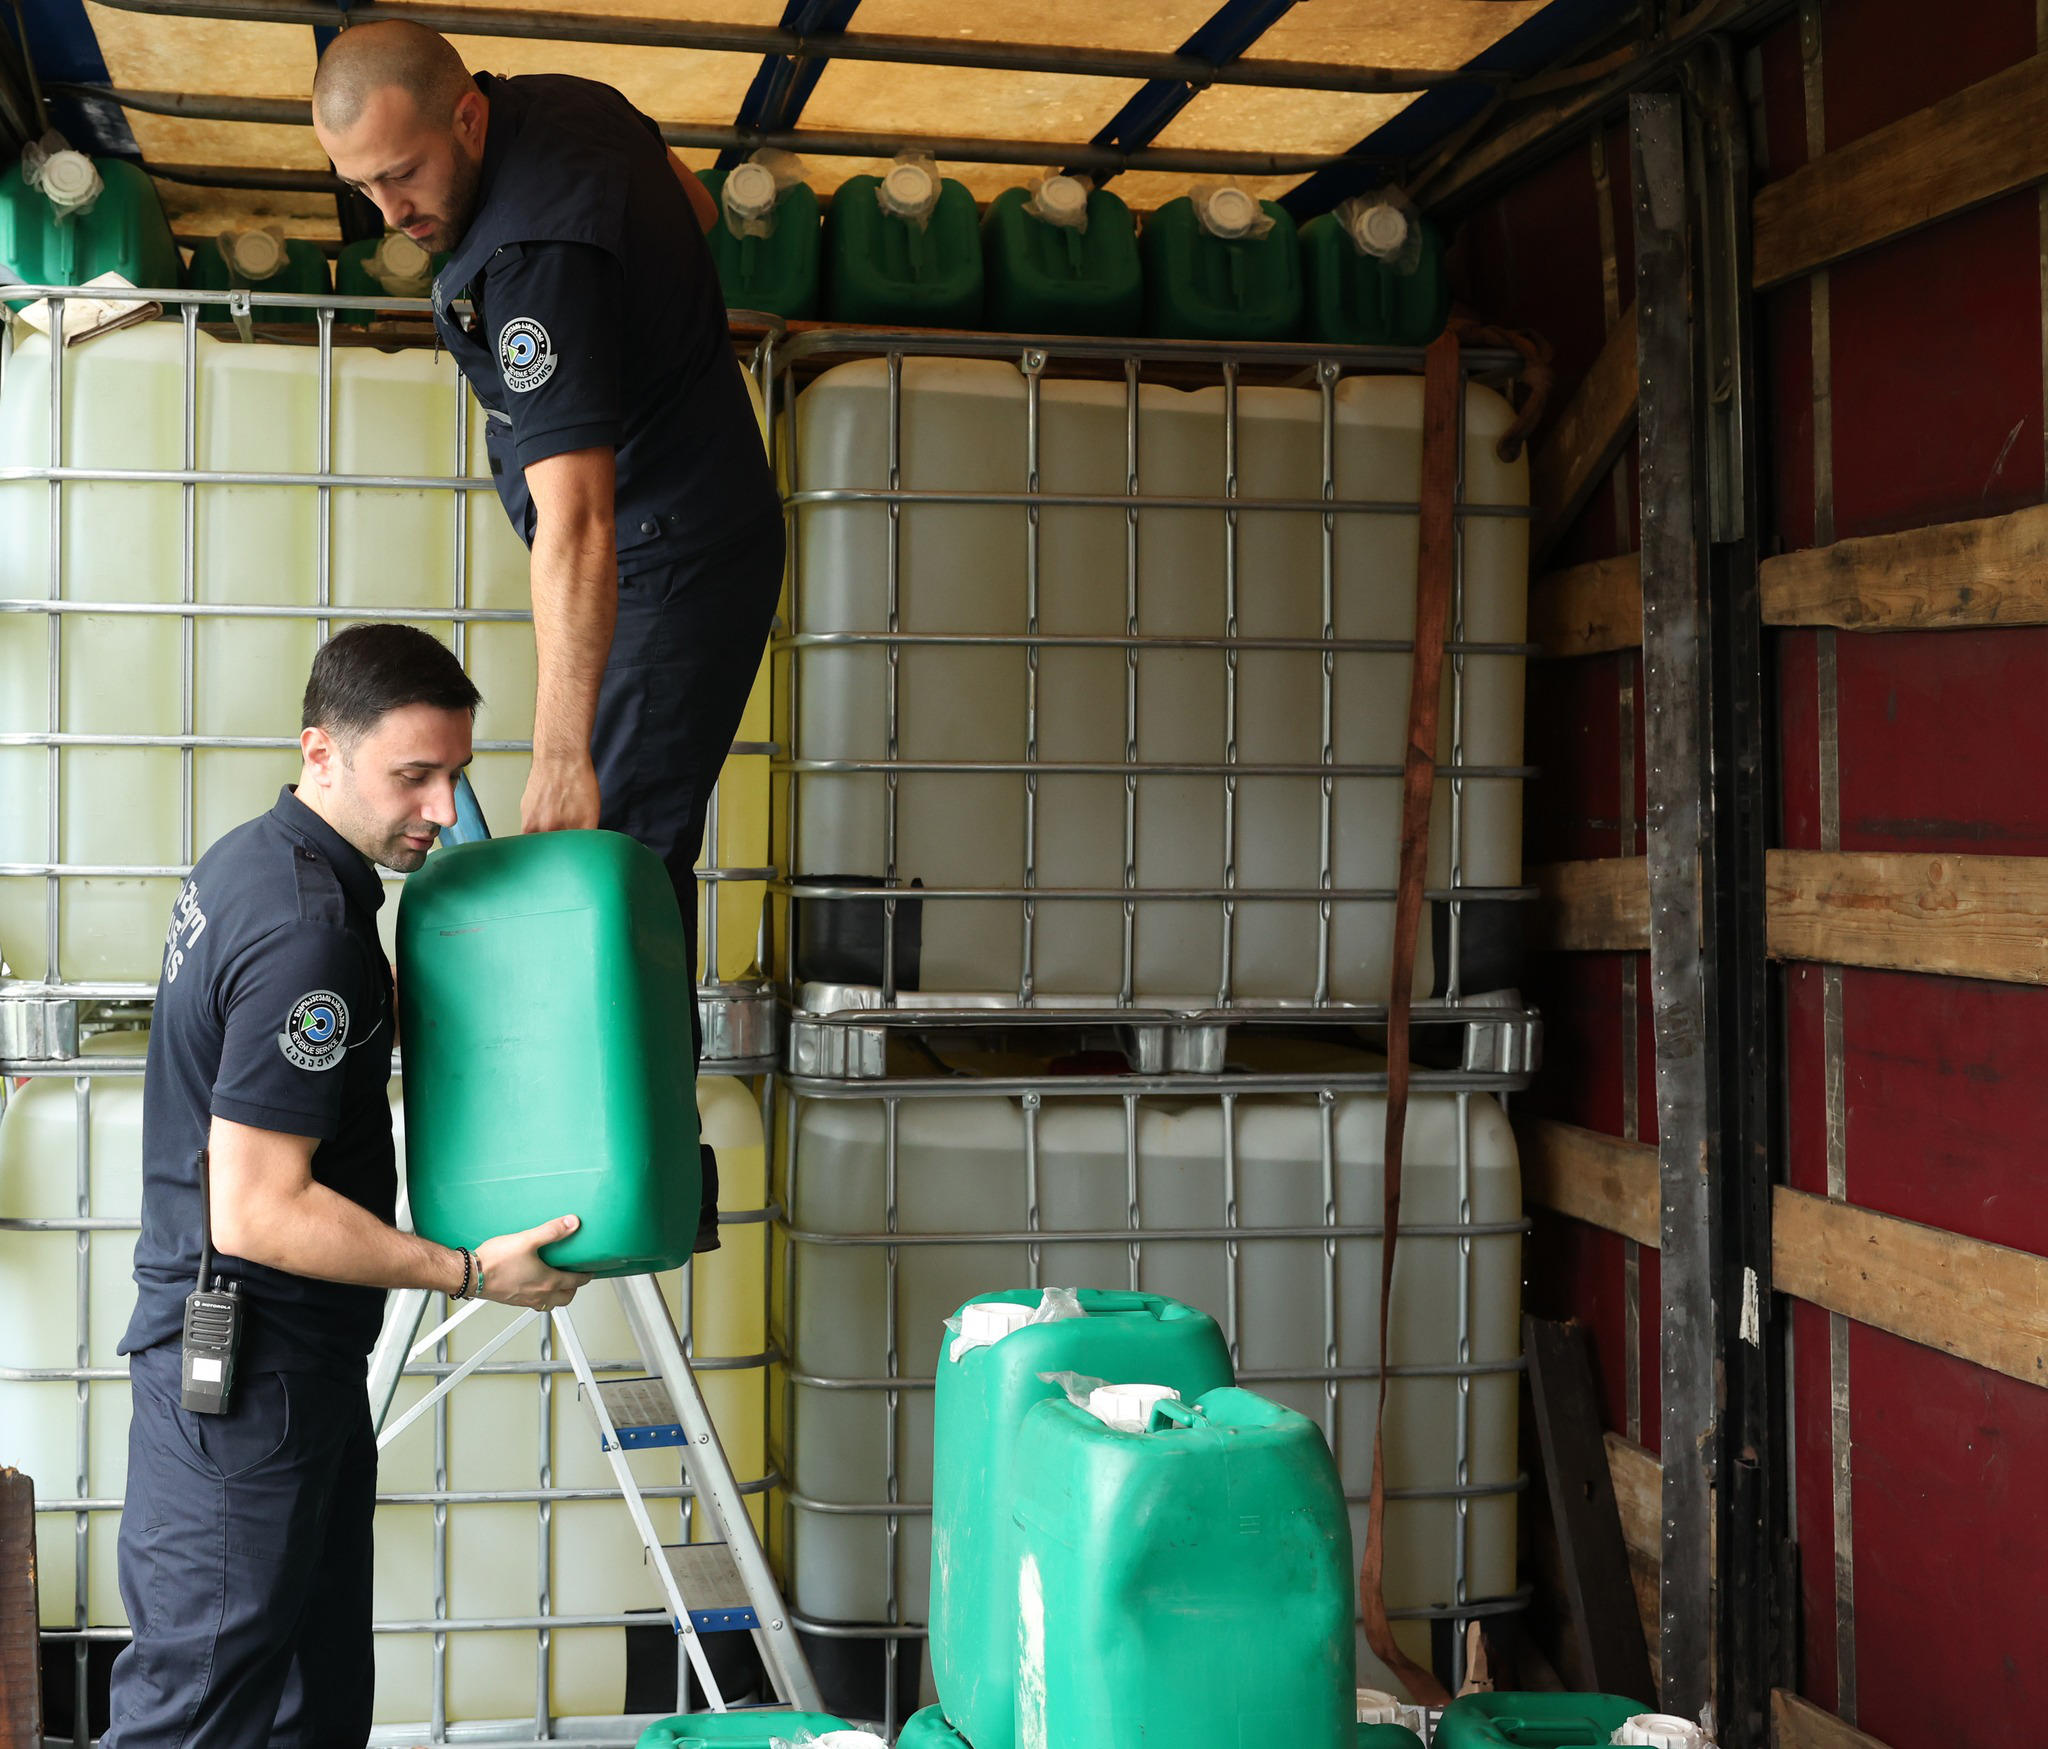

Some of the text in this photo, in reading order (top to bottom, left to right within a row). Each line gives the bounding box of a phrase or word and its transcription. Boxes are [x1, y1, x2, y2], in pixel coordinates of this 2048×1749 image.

[508, 353, 546, 378] REVENUE SERVICE
[508, 363, 553, 390] CUSTOMS
[291, 1031, 339, 1055] REVENUE SERVICE
[286, 1045, 335, 1067] საბაჟო
